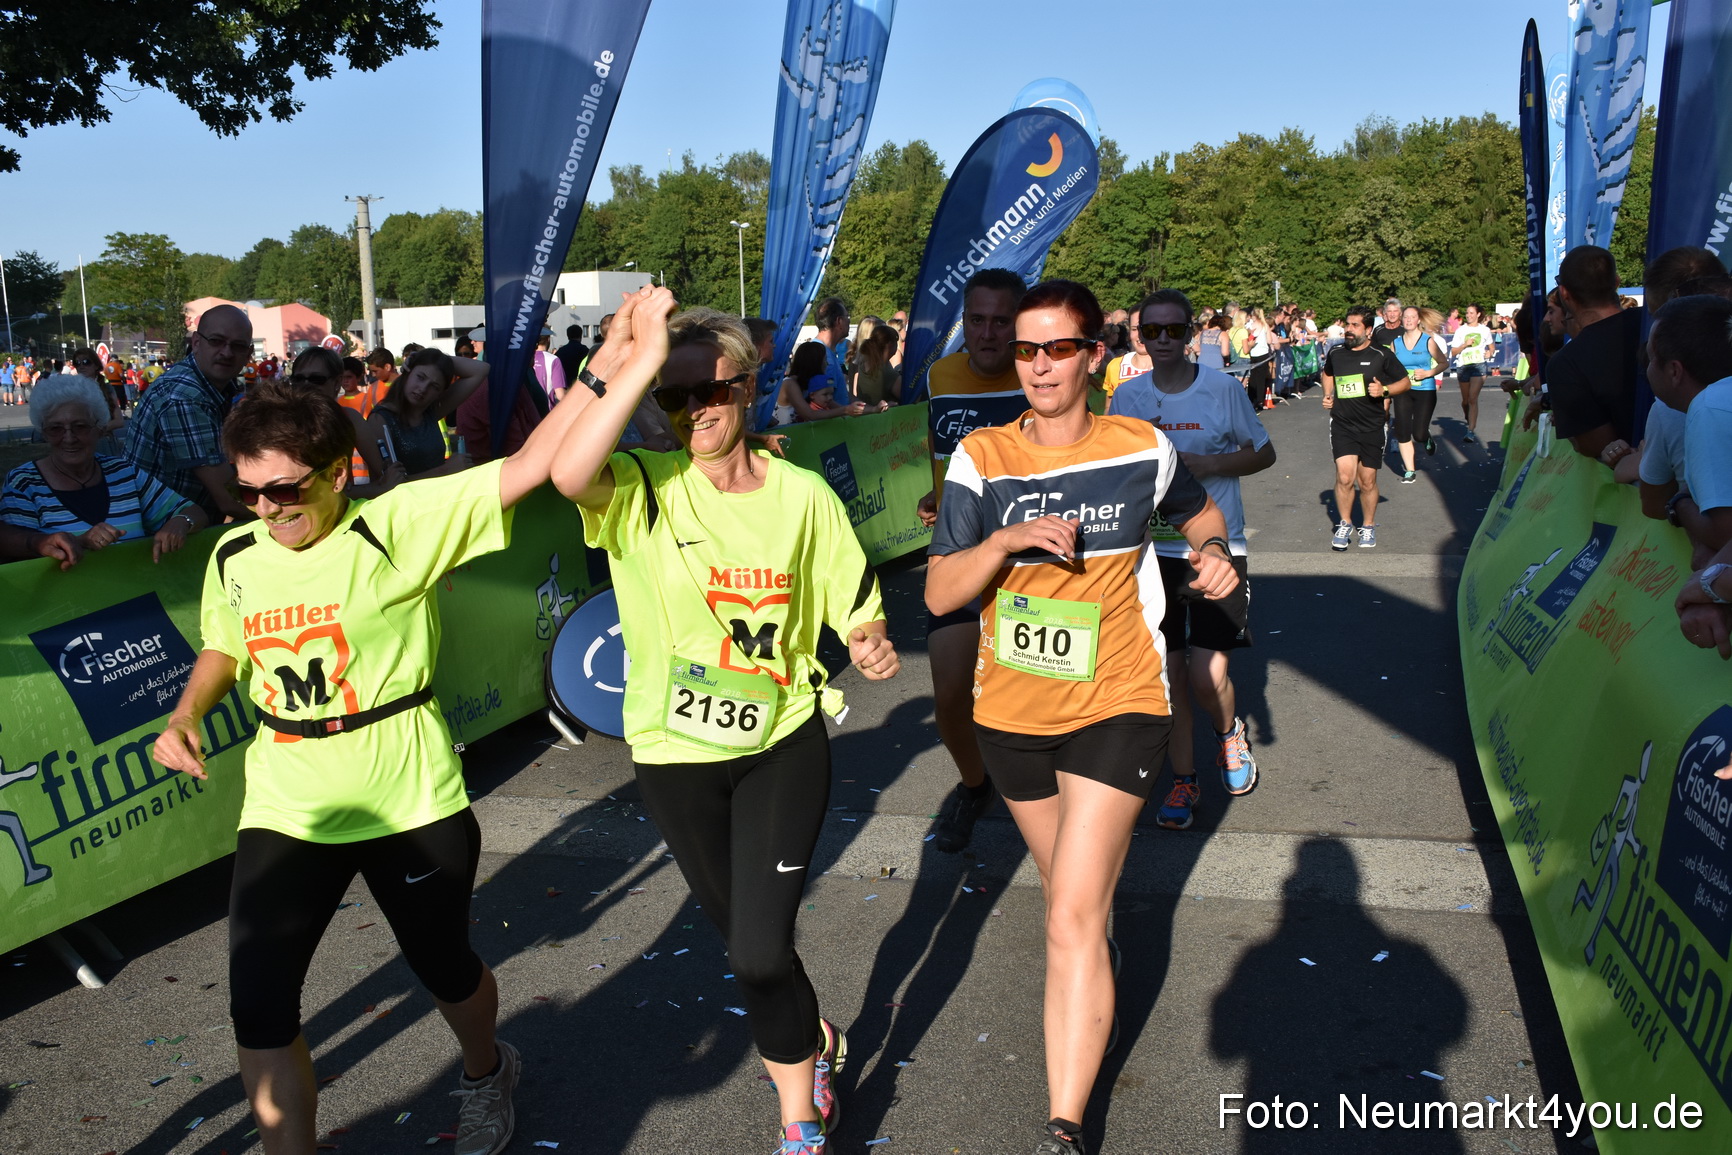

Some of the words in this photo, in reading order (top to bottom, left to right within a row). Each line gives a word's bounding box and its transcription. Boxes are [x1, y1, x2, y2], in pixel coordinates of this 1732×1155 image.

[508, 50, 615, 351] www.fischer-automobile.de
[1009, 214, 1037, 246] Druck
[1036, 197, 1056, 222] und
[1053, 165, 1088, 203] Medien
[929, 183, 1046, 305] Frischmann
[1340, 383, 1356, 392] 751
[1159, 422, 1205, 431] KLEBL
[847, 476, 887, 527] enlauf
[708, 566, 794, 589] Müller
[243, 603, 340, 640] Müller
[1007, 603, 1041, 616] firmenlauf
[80, 634, 162, 676] Fischer
[729, 618, 779, 660] M
[1013, 649, 1040, 662] Schmid
[1042, 655, 1071, 666] Kerstin
[1014, 622, 1071, 657] 610
[102, 651, 169, 684] AUTOMOBILE
[682, 671, 718, 687] firmenlauf
[1008, 655, 1026, 665] Fischer
[1026, 660, 1056, 671] Automobile
[128, 684, 147, 702] und
[146, 676, 164, 691] das
[156, 684, 179, 707] fährt
[274, 657, 333, 712] M
[674, 688, 759, 732] 2136
[1685, 761, 1732, 828] Fischer
[70, 777, 204, 859] neumarkt
[1684, 804, 1726, 851] AUTOMOBILE
[1684, 855, 1697, 875] und
[1614, 844, 1732, 1085] firmenl
[1600, 953, 1668, 1063] neumarkt
